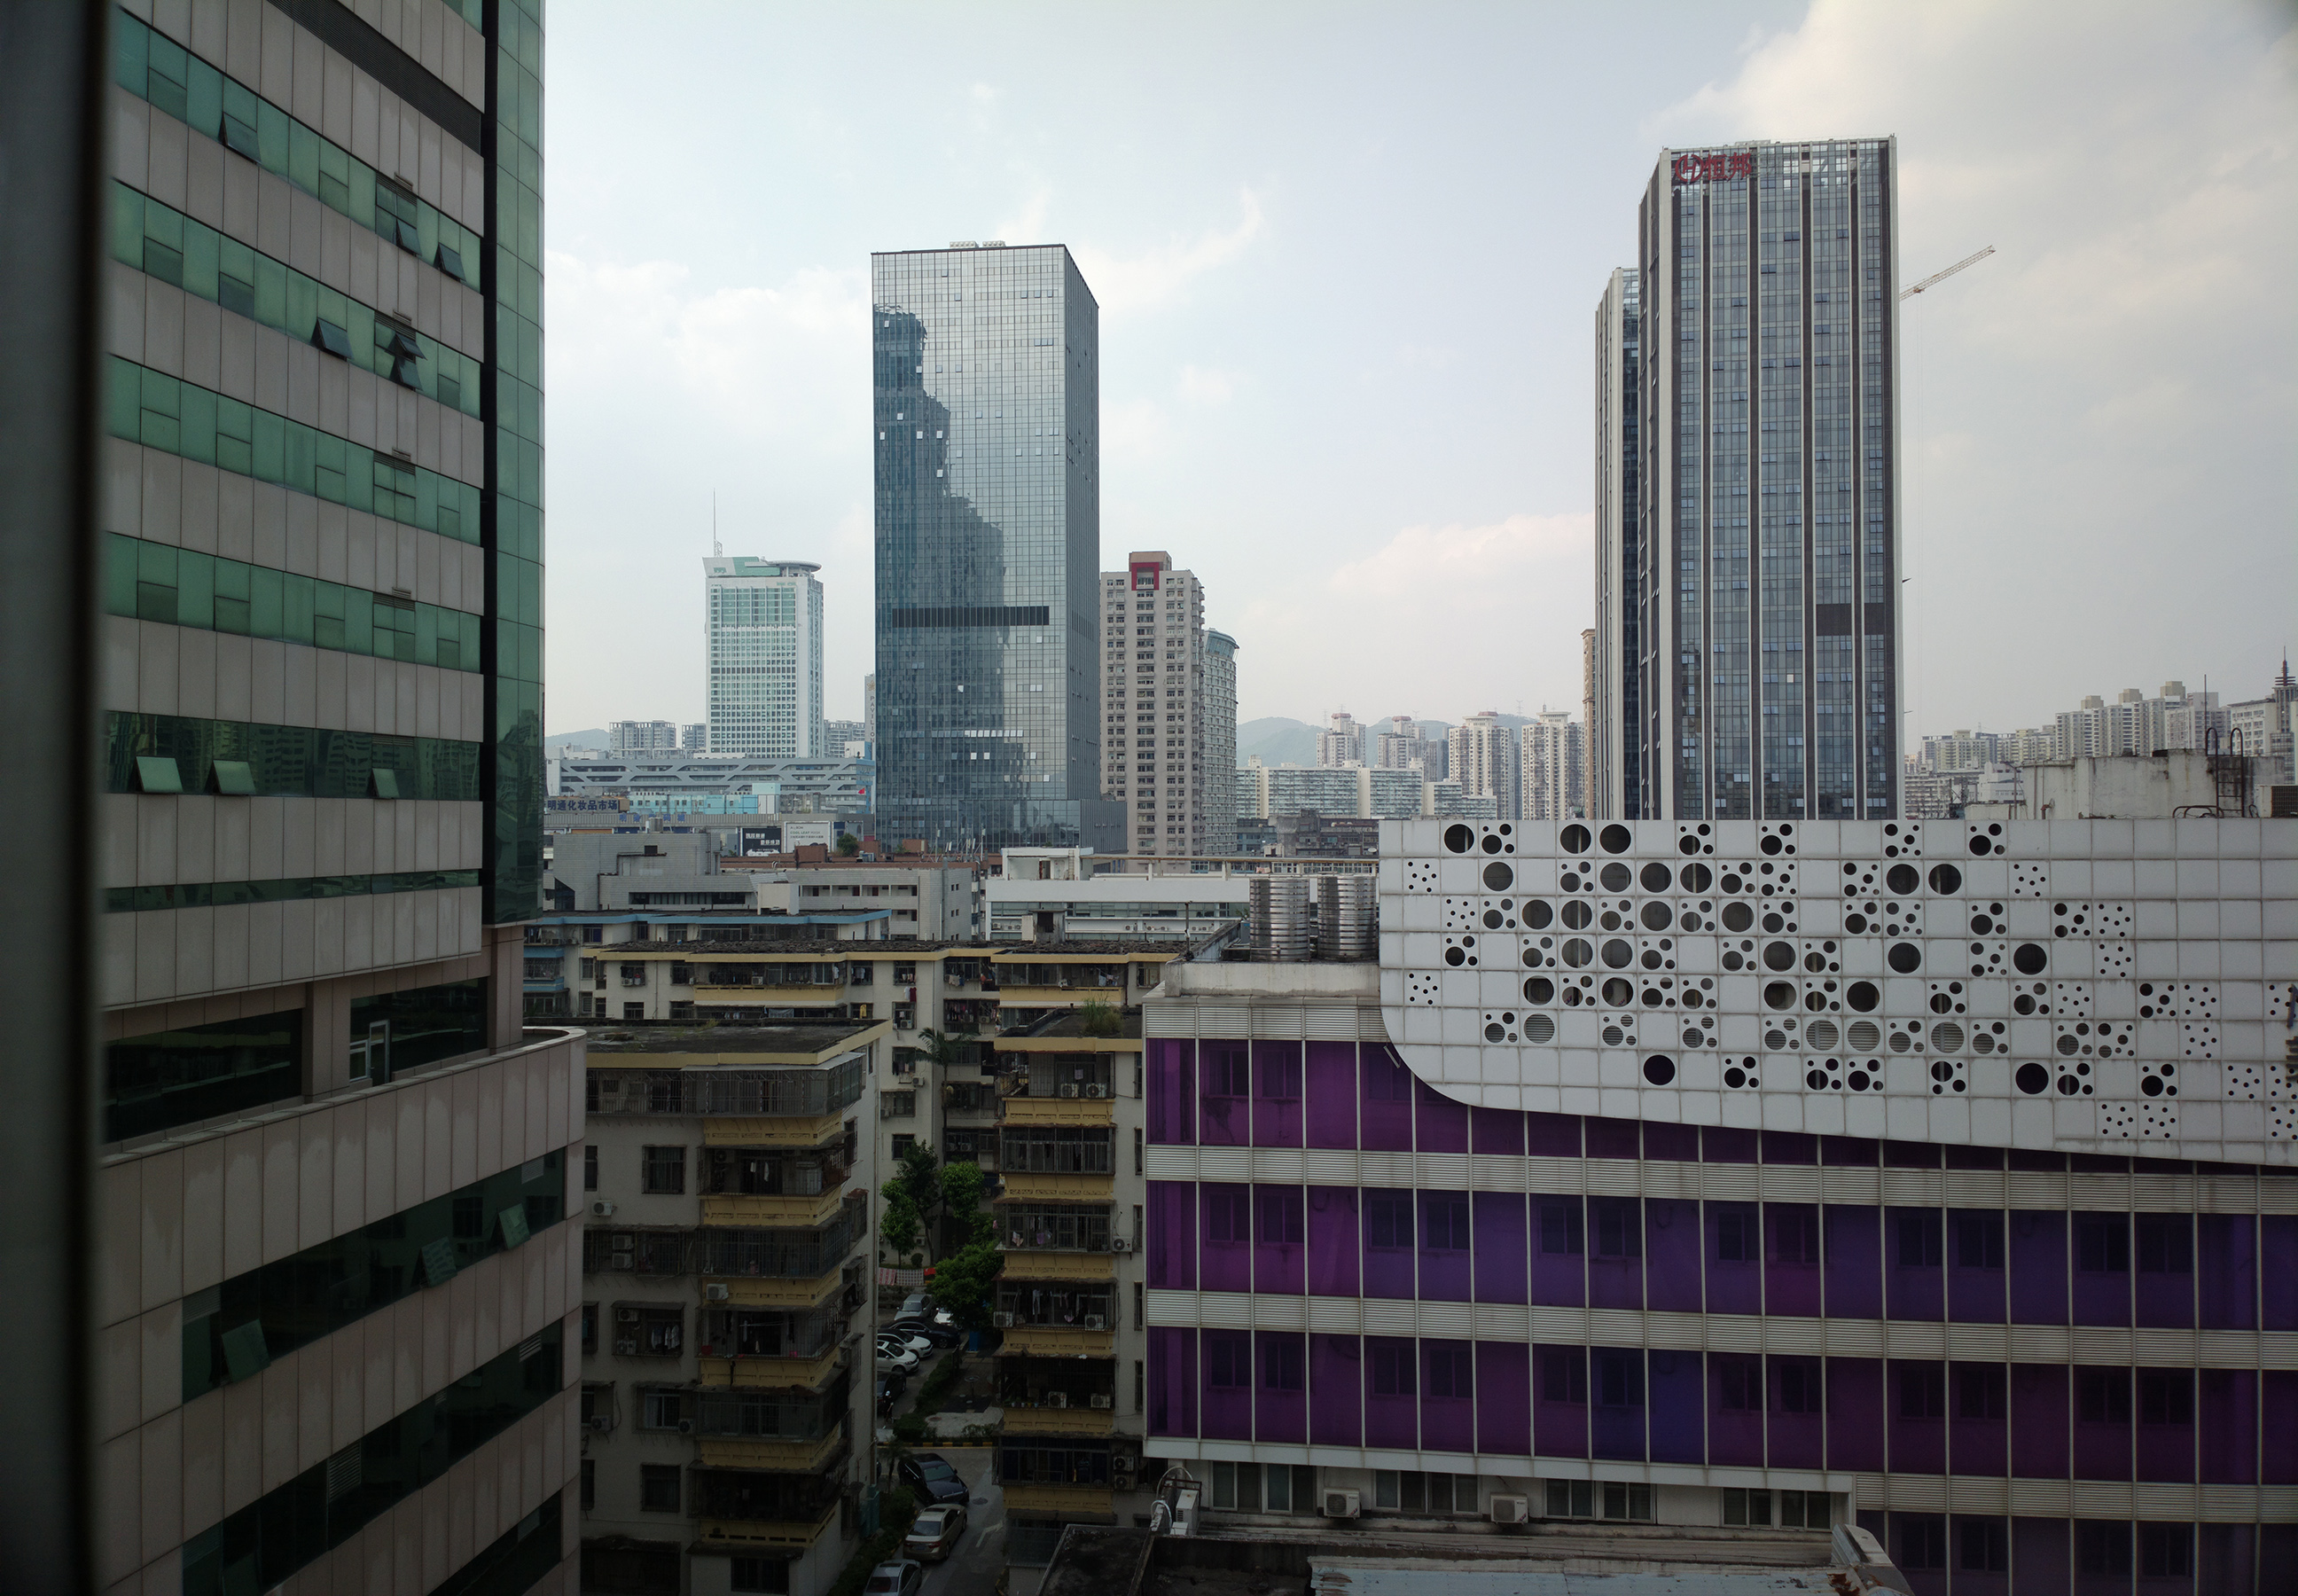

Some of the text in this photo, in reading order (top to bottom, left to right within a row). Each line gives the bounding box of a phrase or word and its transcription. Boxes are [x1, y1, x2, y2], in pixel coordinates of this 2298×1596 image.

[1706, 152, 1752, 180] 恒邦
[547, 800, 618, 811] 明通化妆品市场
